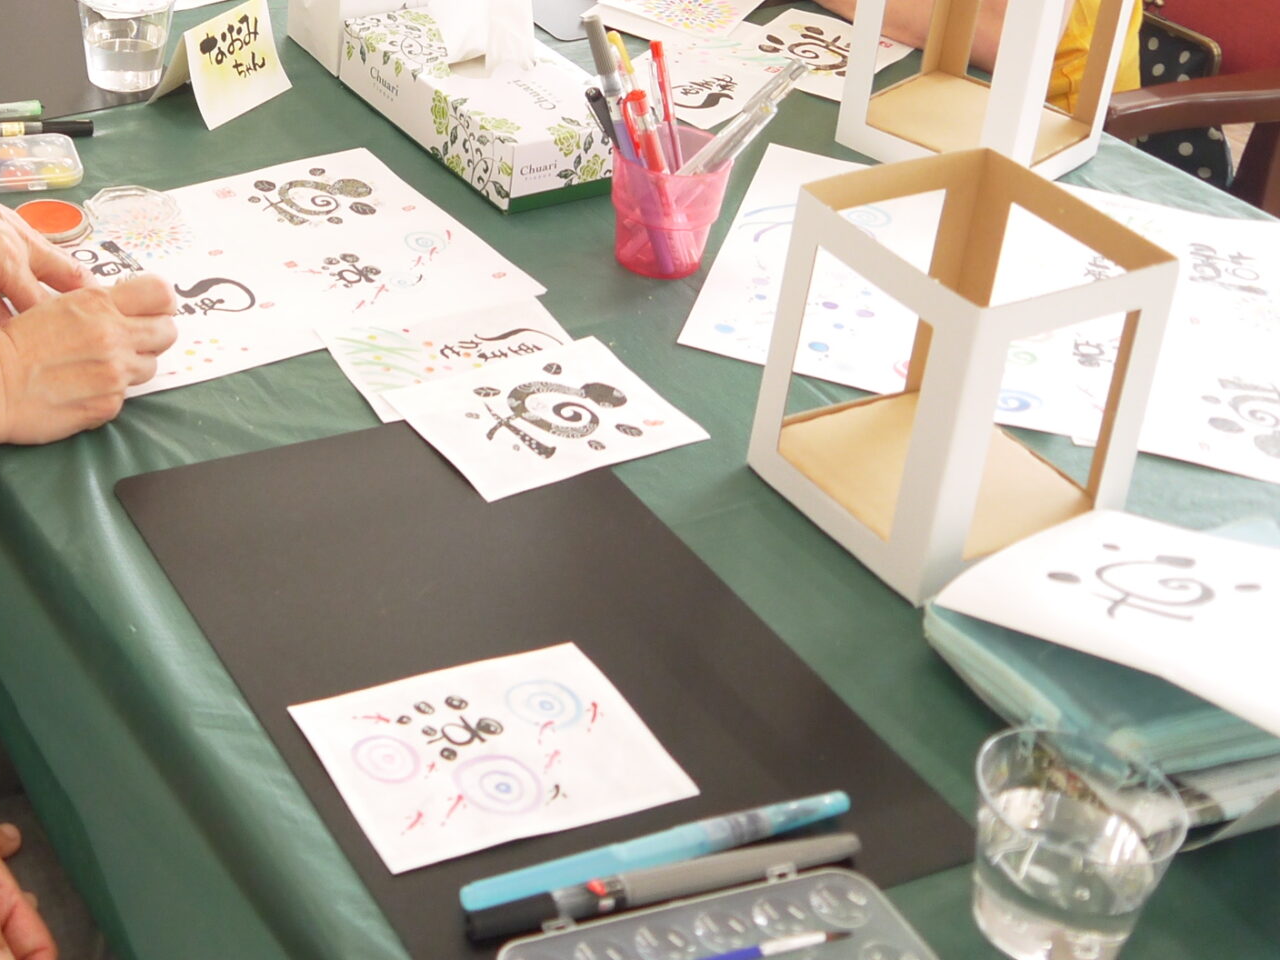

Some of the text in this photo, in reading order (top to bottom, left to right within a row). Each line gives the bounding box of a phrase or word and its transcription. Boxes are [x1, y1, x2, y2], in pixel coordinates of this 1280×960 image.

[199, 14, 259, 65] なおみ
[232, 51, 266, 78] ちゃん
[369, 66, 400, 97] Chuari
[507, 80, 556, 111] Chuari
[520, 160, 558, 176] Chuari
